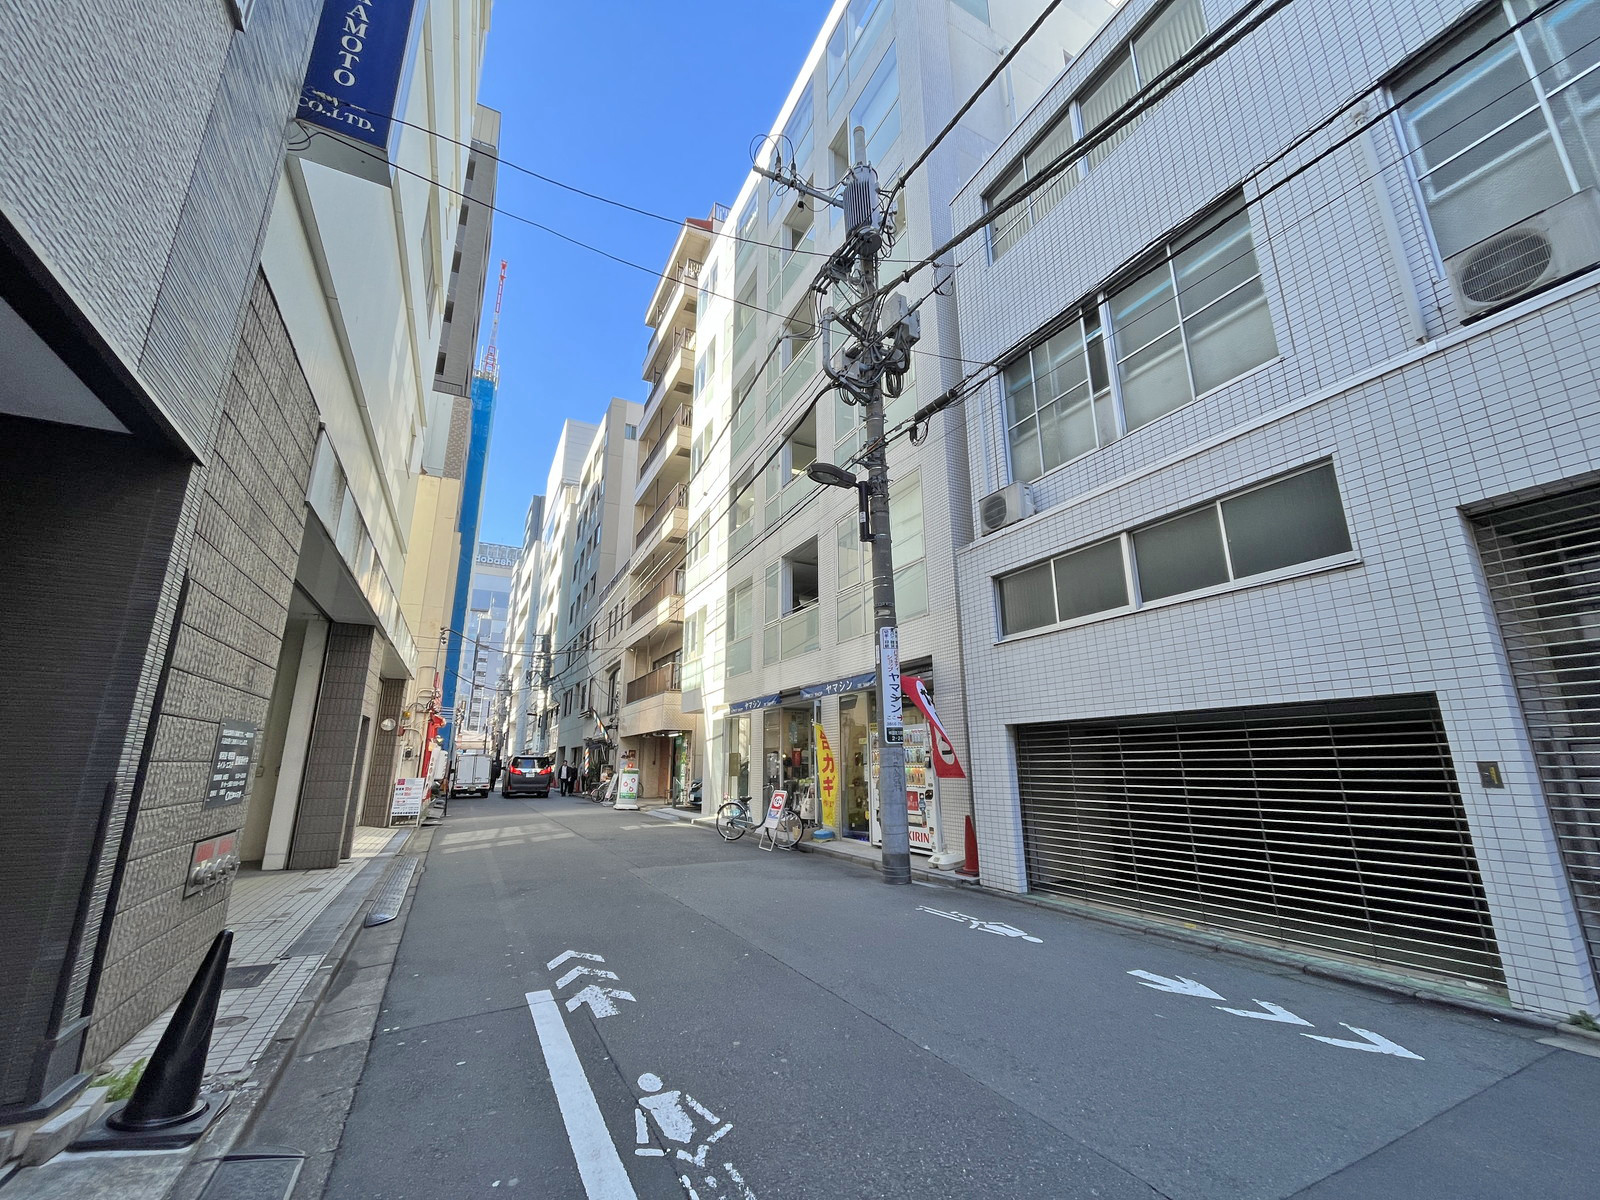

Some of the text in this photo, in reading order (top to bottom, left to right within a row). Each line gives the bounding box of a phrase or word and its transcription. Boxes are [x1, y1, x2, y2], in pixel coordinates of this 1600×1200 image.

[825, 680, 853, 694] ヤマシン
[888, 672, 902, 713] ヤマシン
[744, 700, 761, 710] ヤマシン
[909, 831, 930, 843] KIRIN
